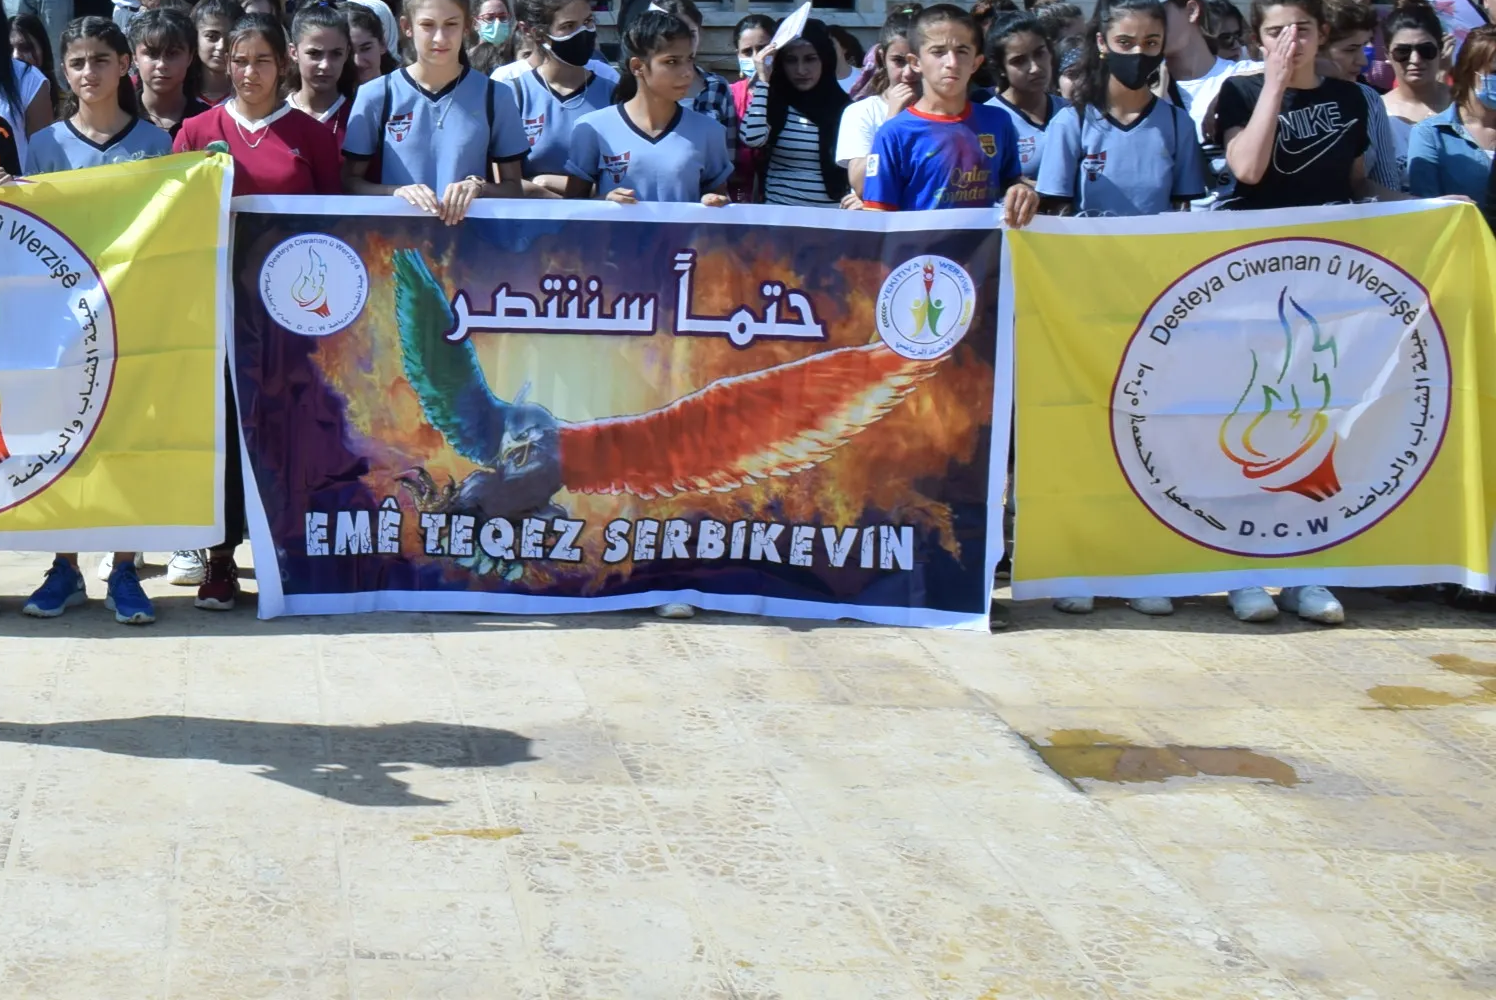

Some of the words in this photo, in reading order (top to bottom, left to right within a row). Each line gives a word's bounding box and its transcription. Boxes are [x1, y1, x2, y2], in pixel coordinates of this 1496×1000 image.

[1278, 102, 1343, 142] NIKE
[8, 219, 81, 289] Werzişê
[446, 277, 655, 342] سننتصر
[1149, 274, 1224, 346] Desteya
[1227, 254, 1321, 283] Ciwanan
[1326, 255, 1341, 276] û
[1348, 259, 1420, 326] Werzişê
[305, 498, 401, 556] EMÊ
[420, 513, 584, 562] TEQEZ
[603, 517, 914, 570] SERBIKEVIN
